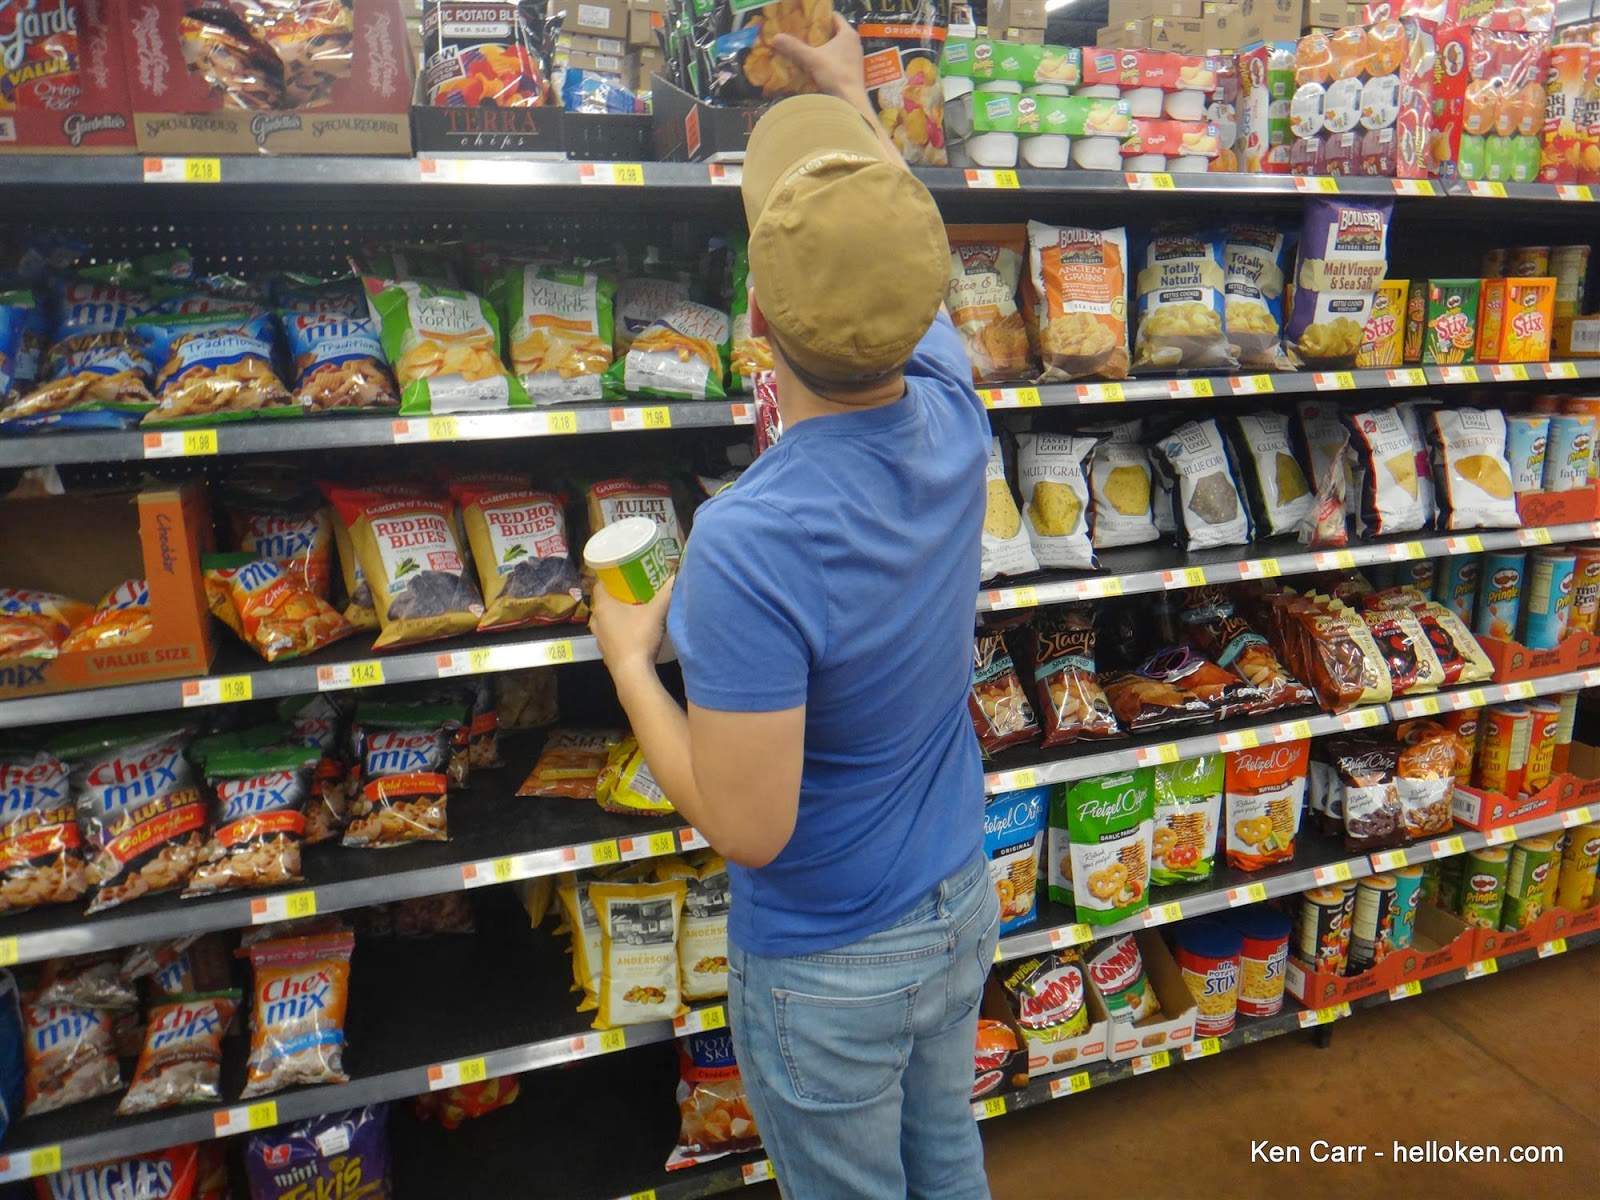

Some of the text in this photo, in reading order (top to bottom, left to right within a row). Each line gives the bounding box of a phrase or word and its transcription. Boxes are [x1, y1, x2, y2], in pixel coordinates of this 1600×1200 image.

[455, 9, 498, 21] POTATO
[145, 117, 238, 137] SPECIAL REQUEST
[312, 118, 400, 137] SPECIAL REQUEST
[443, 109, 541, 133] TERRA
[460, 133, 525, 150] chips
[1340, 209, 1382, 230] BOULDER
[1058, 264, 1109, 276] ANCIENT
[1162, 262, 1200, 276] Totally
[1232, 252, 1264, 273] Totally
[1324, 263, 1382, 279] Malt Vinegar
[1064, 272, 1103, 282] GRAINS
[1160, 273, 1202, 287] Natural
[1228, 264, 1262, 283] Natural
[1330, 276, 1374, 290] & Sea Salt
[948, 278, 976, 298] Rice
[306, 319, 371, 343] mix
[1365, 316, 1396, 341] Stix
[1436, 316, 1467, 341] Stix
[1512, 314, 1543, 338] Stix
[646, 412, 664, 425] $1.98
[1466, 420, 1486, 428] GOOD
[189, 434, 209, 450] $1.98
[1184, 433, 1202, 443] TASTE
[1189, 440, 1207, 450] GOOD
[1373, 440, 1398, 455] KETTLE
[1448, 438, 1480, 451] SWEET
[1183, 462, 1204, 476] BLUE
[1519, 473, 1534, 482] fat
[1560, 468, 1574, 479] fat
[366, 502, 403, 514] GARDEN
[404, 500, 416, 510] of
[480, 492, 518, 505] GARDEN
[614, 499, 667, 513] MULTI
[488, 504, 559, 525] RED HOT
[375, 516, 447, 538] RED HOT
[500, 516, 556, 537] BLUES
[256, 527, 319, 559] mix
[389, 530, 447, 549] BLUES
[92, 647, 190, 670] VALUE SIZE
[351, 665, 374, 679] $1.42
[975, 667, 995, 679] SIMPLY
[224, 682, 245, 697] $1.98
[367, 730, 442, 750] Chex
[86, 743, 178, 787] Chex
[368, 748, 430, 772] mix
[1234, 750, 1276, 778] Pretzel
[104, 754, 179, 813] mix
[217, 770, 293, 800] Chex
[1258, 785, 1280, 793] BUFFALO
[225, 782, 290, 821] mix
[1077, 793, 1122, 825] Pretzel
[108, 798, 167, 837] VALUE
[119, 826, 152, 852] Bold
[1101, 833, 1120, 841] GARLIC
[1000, 841, 1031, 856] ORIGINAL
[1466, 892, 1498, 904] Pringles
[617, 955, 670, 965] ANDERSON
[1090, 936, 1137, 985] Combos
[1218, 962, 1233, 971] utz
[262, 964, 333, 1004] Chex
[1204, 976, 1236, 996] STIX
[267, 985, 330, 1025] mix
[154, 1003, 215, 1032] Chex
[37, 1007, 100, 1052] mix
[154, 1016, 220, 1049] mix
[1171, 1028, 1191, 1039] CHEESY
[1150, 1054, 1165, 1066] $2.98
[1070, 1077, 1086, 1089] $2.98
[984, 1102, 1001, 1113] $2.98
[275, 1160, 318, 1187] mini
[278, 1156, 363, 1200] Takis
